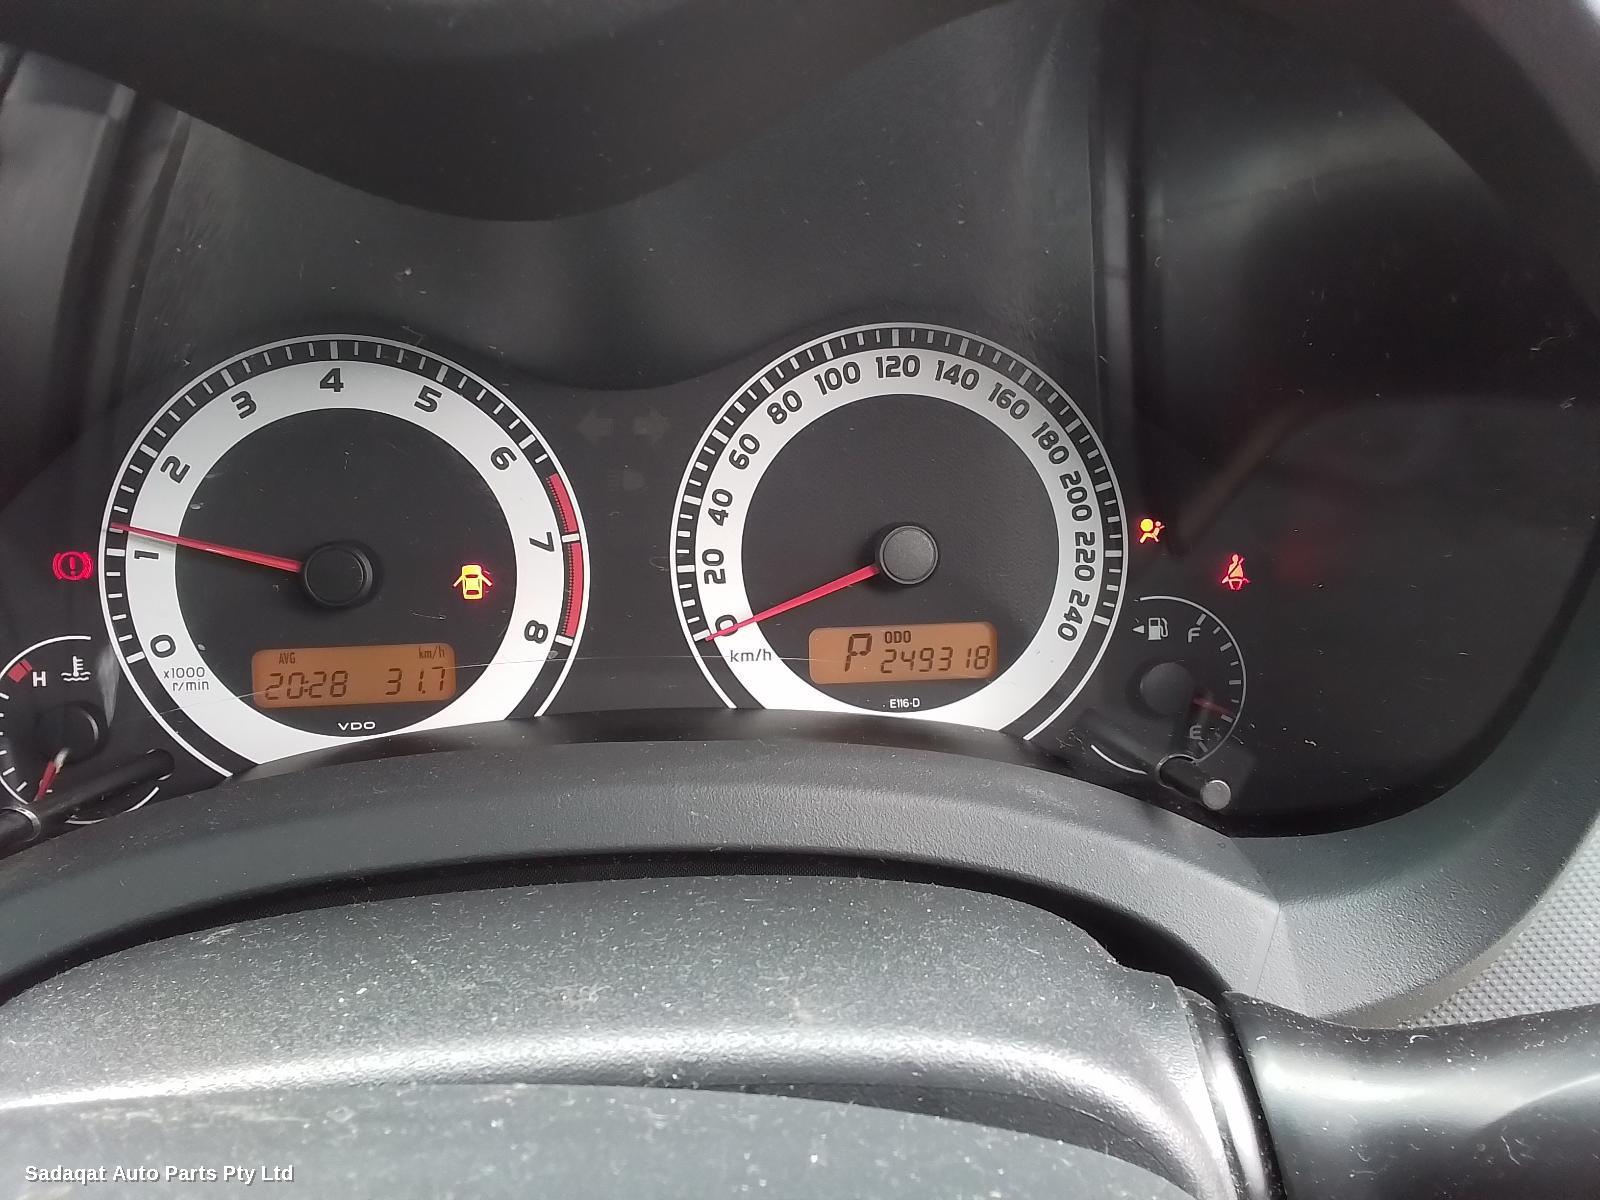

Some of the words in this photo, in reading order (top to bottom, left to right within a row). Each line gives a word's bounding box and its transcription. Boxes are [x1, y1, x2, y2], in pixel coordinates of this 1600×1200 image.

[814, 361, 861, 395] 100
[876, 355, 920, 378] 120
[934, 360, 980, 391] 140
[319, 368, 344, 392] 4
[231, 390, 257, 419] 3
[414, 385, 442, 412] 5
[767, 390, 803, 424] 80
[988, 383, 1030, 420] 160
[729, 434, 760, 470] 60
[1030, 421, 1070, 465] 180
[161, 456, 190, 484] 2
[490, 447, 517, 470] 6
[707, 489, 733, 526] 40
[1060, 471, 1092, 521] 200
[529, 531, 554, 553] 7
[134, 550, 160, 561] 1
[702, 549, 725, 585] 20
[1074, 531, 1096, 582] 220
[714, 614, 738, 637] 0
[1057, 590, 1090, 641] 240
[524, 620, 549, 643] 8
[884, 631, 911, 643] ODO
[1188, 628, 1201, 642] F
[151, 634, 176, 658] 0
[418, 647, 445, 659] km/h
[729, 649, 772, 663] km/h
[845, 633, 873, 672] P
[880, 645, 989, 674] 249318
[278, 653, 296, 664] AVG
[33, 671, 46, 687] H
[163, 666, 205, 679] x1000
[265, 670, 349, 700] 20:28
[385, 667, 445, 695] 31.7
[172, 679, 210, 691] r/min
[338, 721, 376, 731] VDO
[1189, 725, 1201, 740] E
